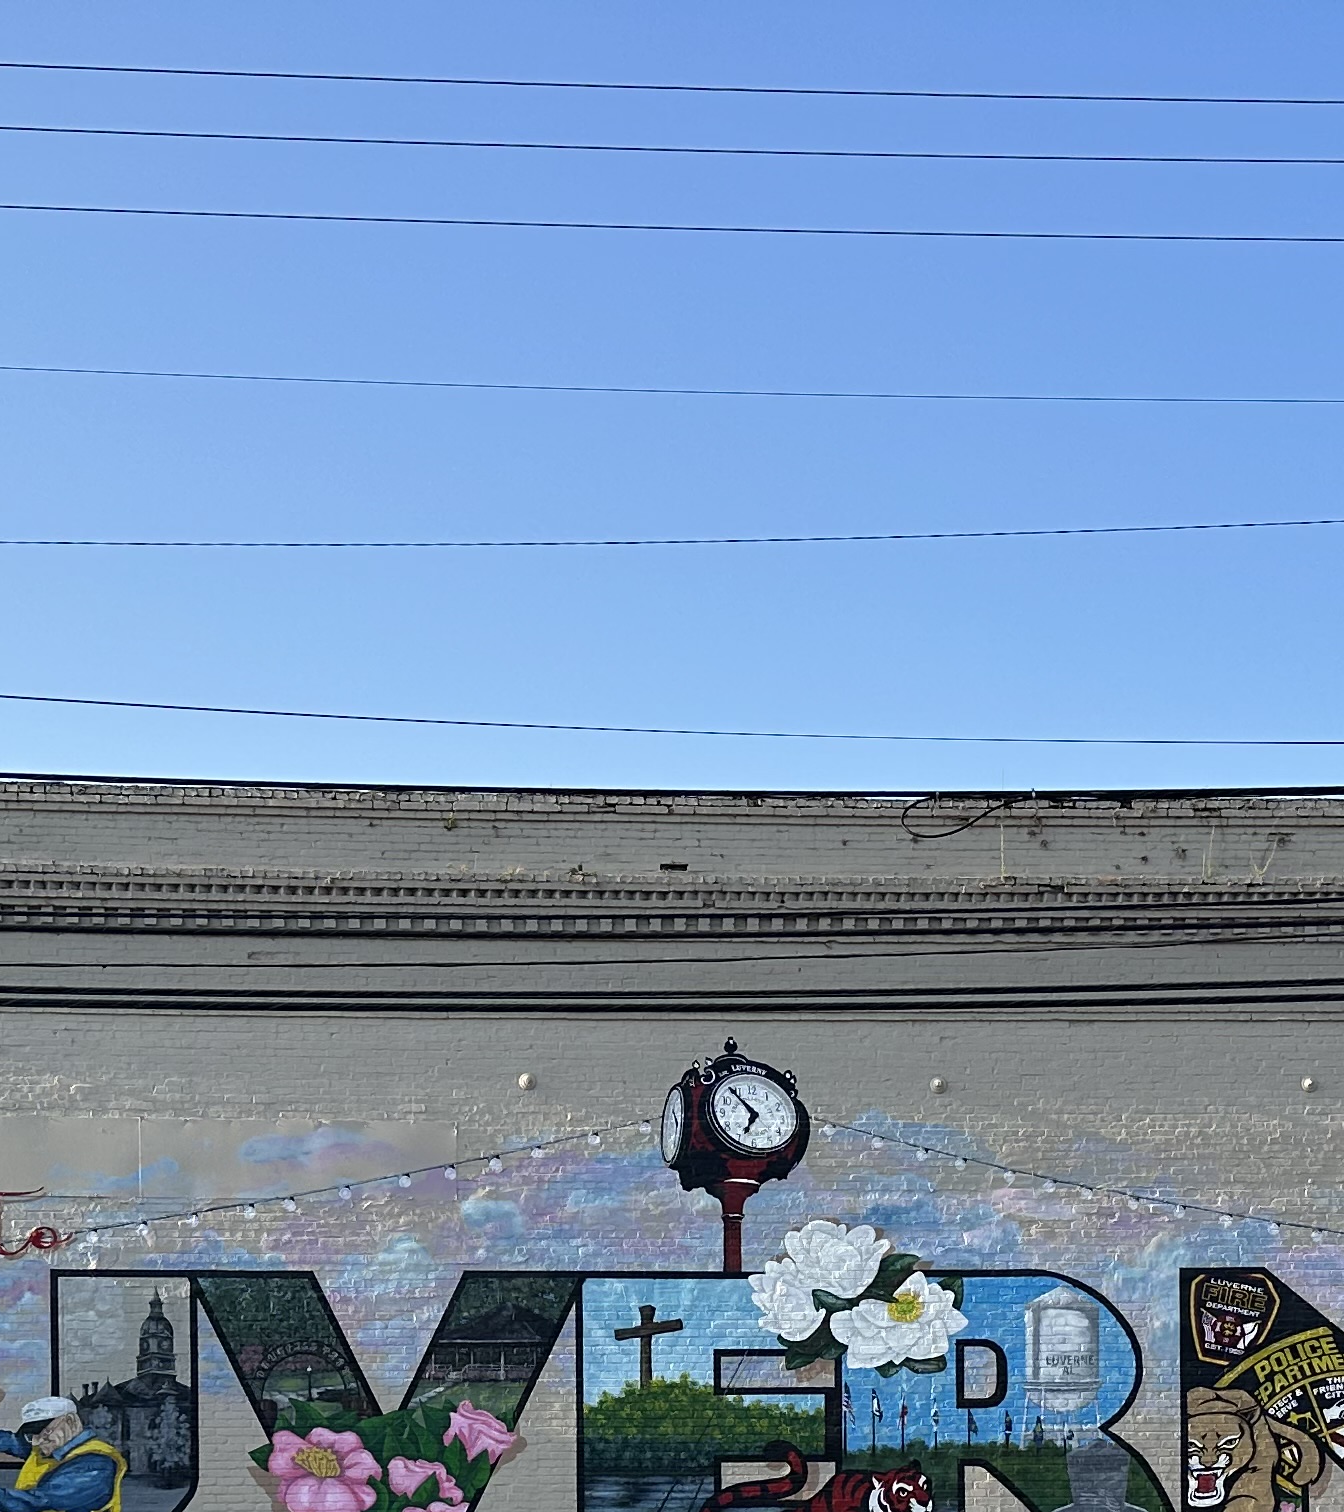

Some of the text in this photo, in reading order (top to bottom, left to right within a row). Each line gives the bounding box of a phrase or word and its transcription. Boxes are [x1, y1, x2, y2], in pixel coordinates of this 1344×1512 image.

[1210, 1278, 1264, 1295] LUVERNE
[1202, 1283, 1268, 1312] FIRE
[1206, 1301, 1260, 1317] DEPARTMENT
[1045, 1354, 1095, 1366] LUVERNE
[1254, 1336, 1339, 1383] POLICE
